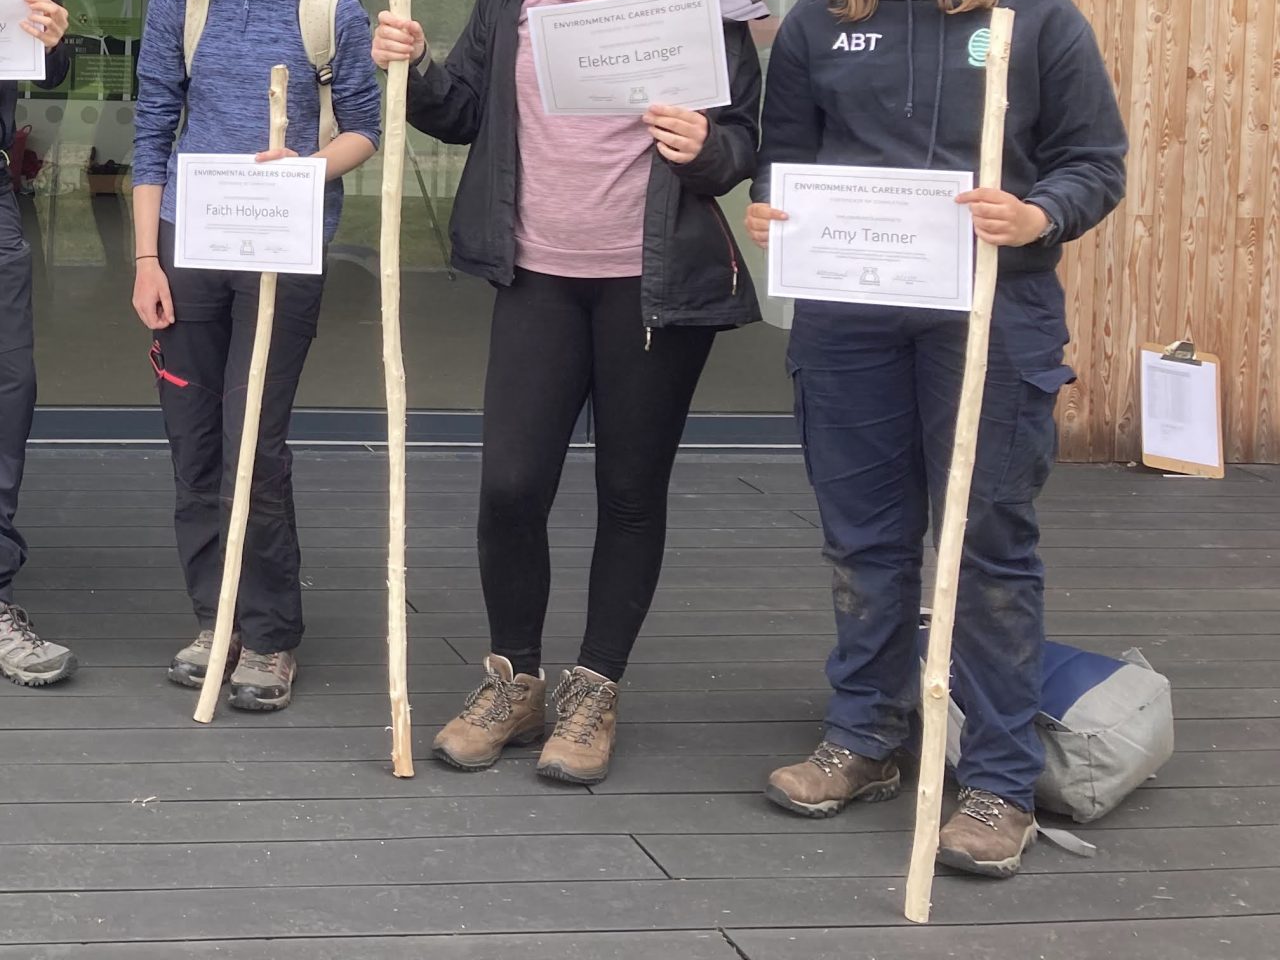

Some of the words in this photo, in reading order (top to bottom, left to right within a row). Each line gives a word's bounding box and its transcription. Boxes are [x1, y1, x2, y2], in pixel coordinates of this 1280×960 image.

[553, 14, 626, 29] ENVIRONMENTAL
[628, 7, 666, 19] CAREERS
[668, 0, 702, 13] COURSE
[832, 32, 883, 51] ABT
[579, 52, 630, 68] Elektra
[635, 44, 683, 63] Langer
[194, 169, 246, 177] ENVIRONMENTAL
[247, 170, 279, 178] CAREERS
[281, 171, 311, 179] COURSE
[794, 182, 869, 194] ENVIRONMENTAL
[871, 185, 913, 196] CAREERS
[915, 188, 953, 198] COURSE
[206, 204, 233, 216] Faith
[236, 205, 289, 220] Holyoake
[821, 226, 857, 244] Amy
[862, 228, 917, 244] Tanner
